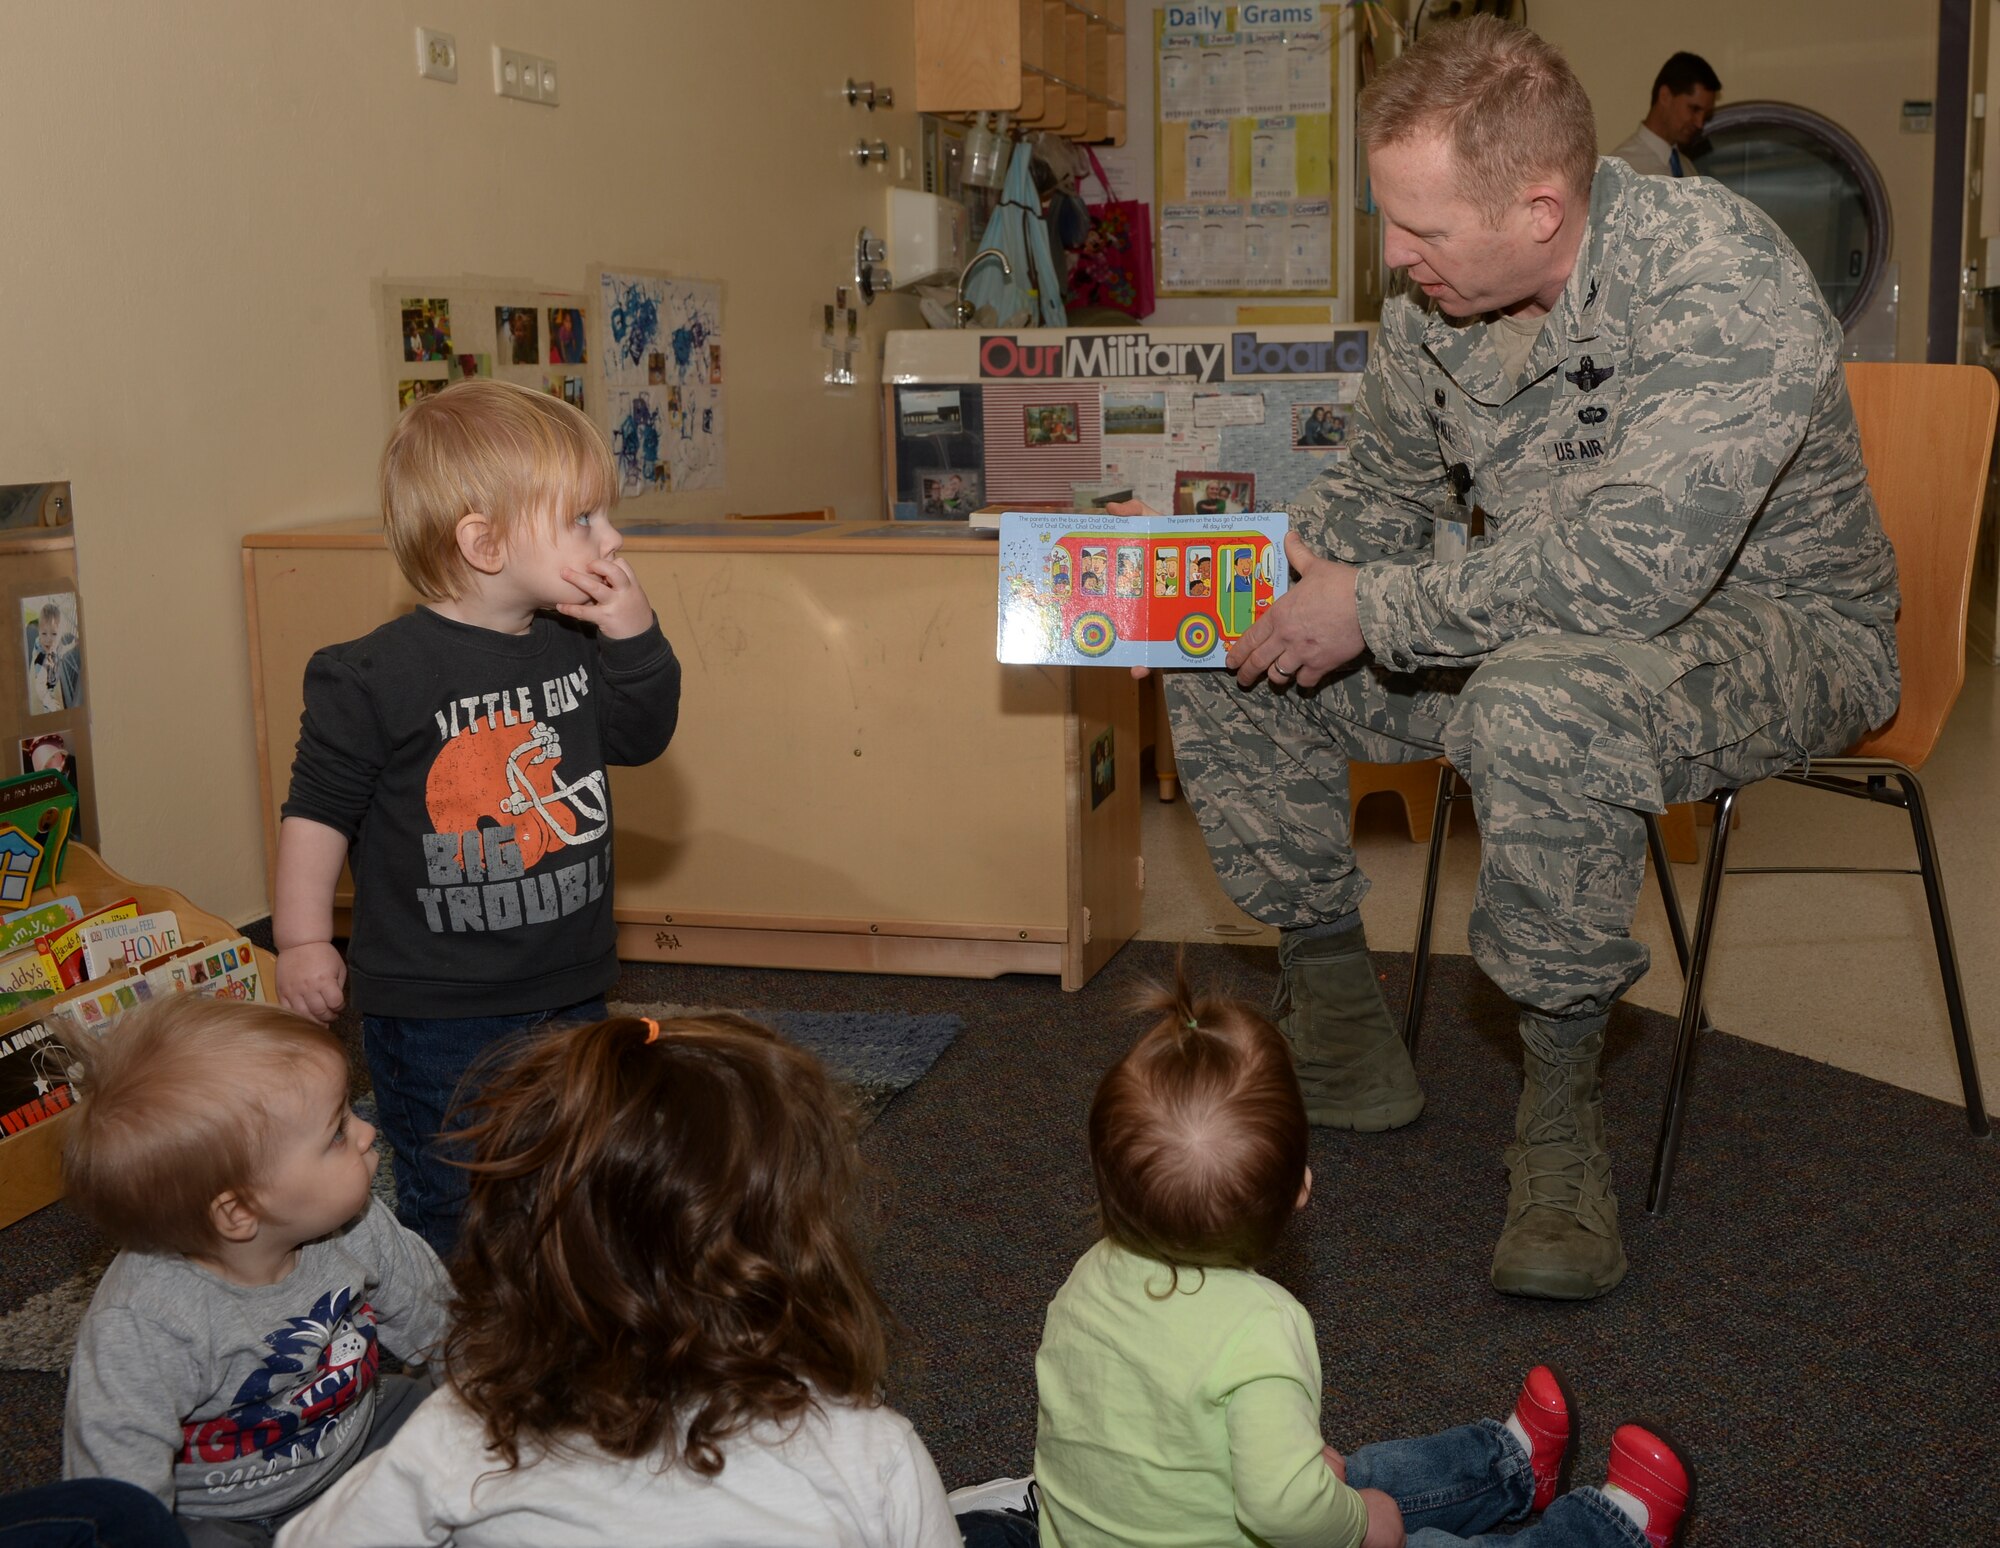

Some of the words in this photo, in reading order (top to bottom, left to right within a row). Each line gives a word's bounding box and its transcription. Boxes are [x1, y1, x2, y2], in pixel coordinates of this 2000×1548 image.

[1169, 6, 1222, 29] Daily
[1244, 5, 1313, 24] Grams
[1296, 203, 1326, 216] Cooper
[981, 336, 1061, 377] Our
[1066, 335, 1224, 385] Military
[1234, 331, 1366, 373] Board
[1554, 442, 1577, 461] U.S.
[1579, 439, 1604, 459] AIR
[434, 686, 534, 741] LITTLE
[542, 664, 589, 718] GUY
[4, 792, 11, 802] in
[14, 788, 26, 799] the
[29, 777, 58, 794] House?
[422, 824, 525, 886] BIG
[30, 920, 56, 935] yu
[103, 923, 128, 940] TOUCH
[139, 918, 157, 932] FEEL
[54, 936, 75, 960] Hands
